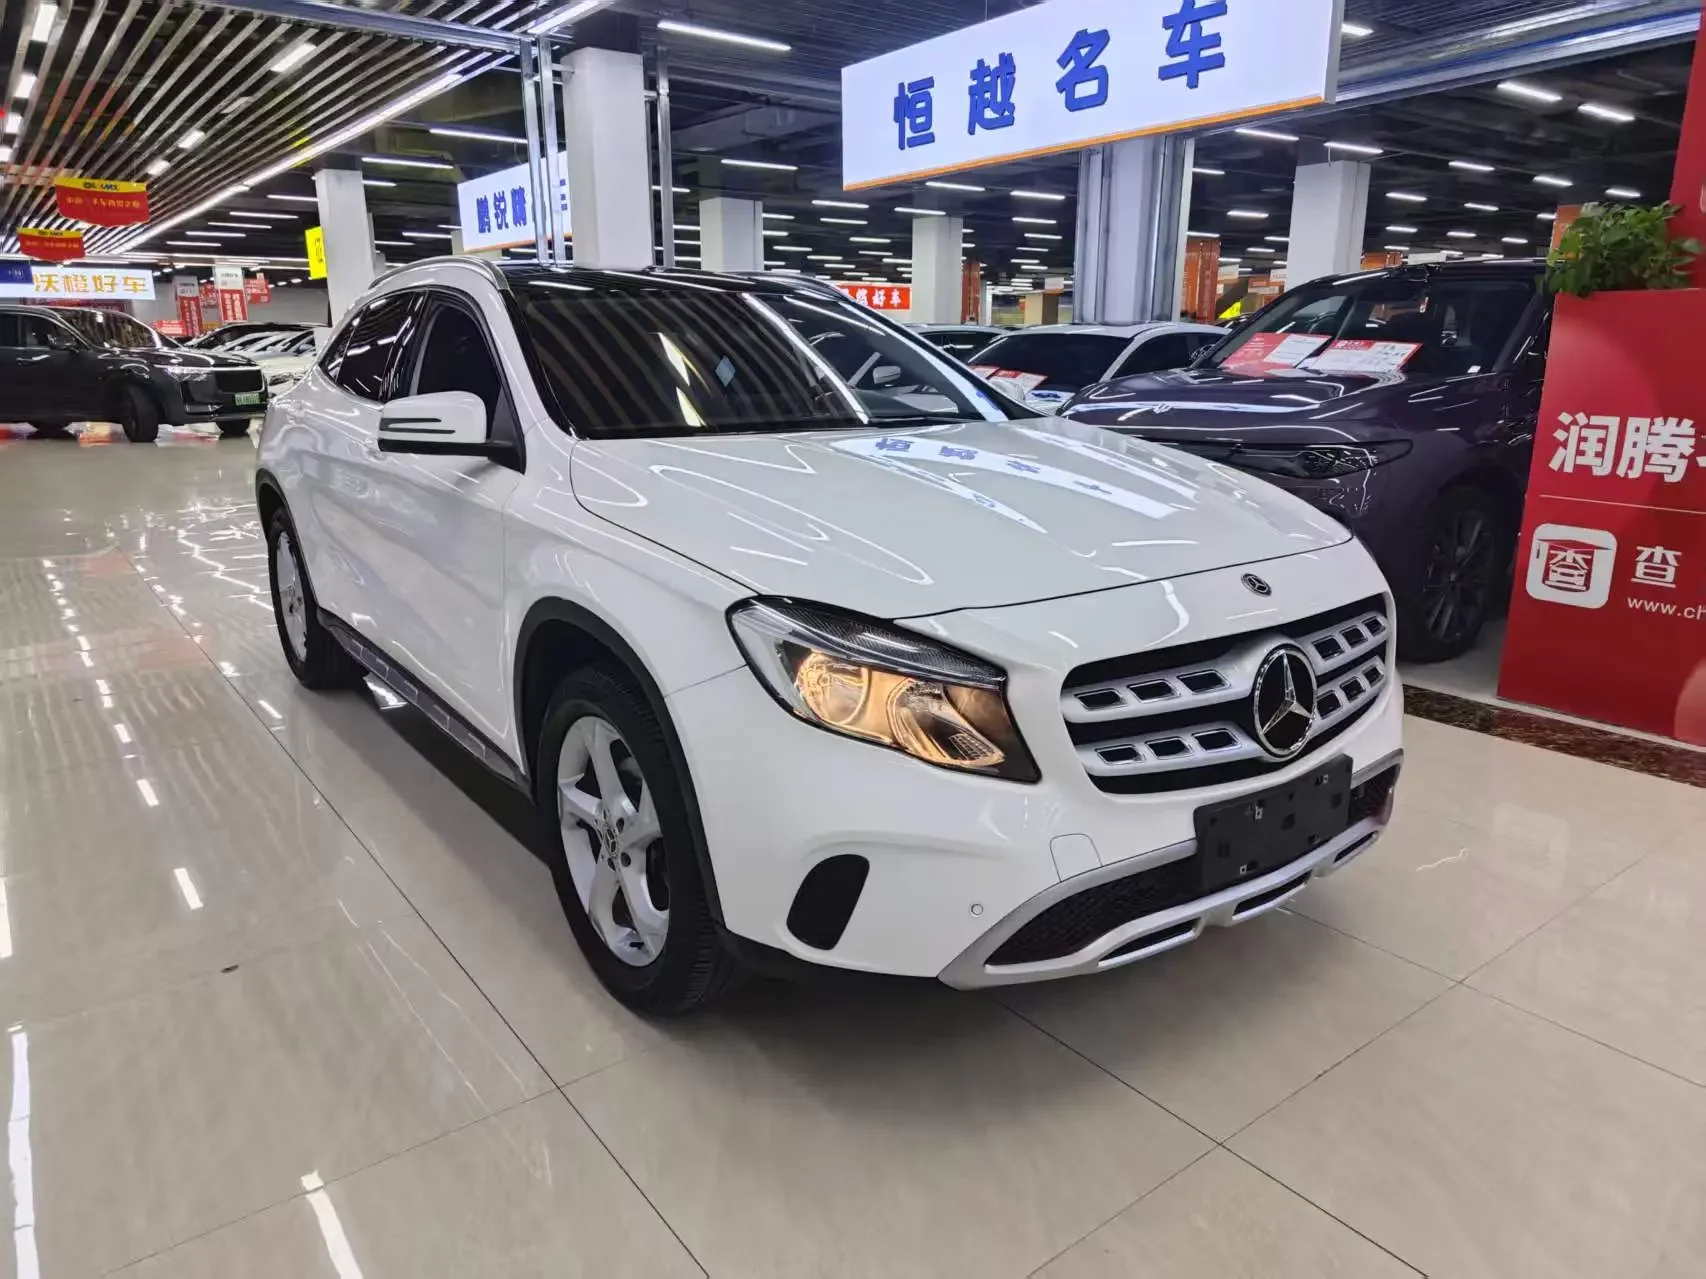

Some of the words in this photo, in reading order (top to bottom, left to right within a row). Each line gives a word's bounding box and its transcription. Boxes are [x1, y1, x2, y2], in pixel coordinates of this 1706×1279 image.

[893, 0, 1228, 150] 恒越名车
[33, 273, 148, 294] 沃橙好车
[1549, 411, 1706, 484] 润腾
[1630, 545, 1683, 588] 查
